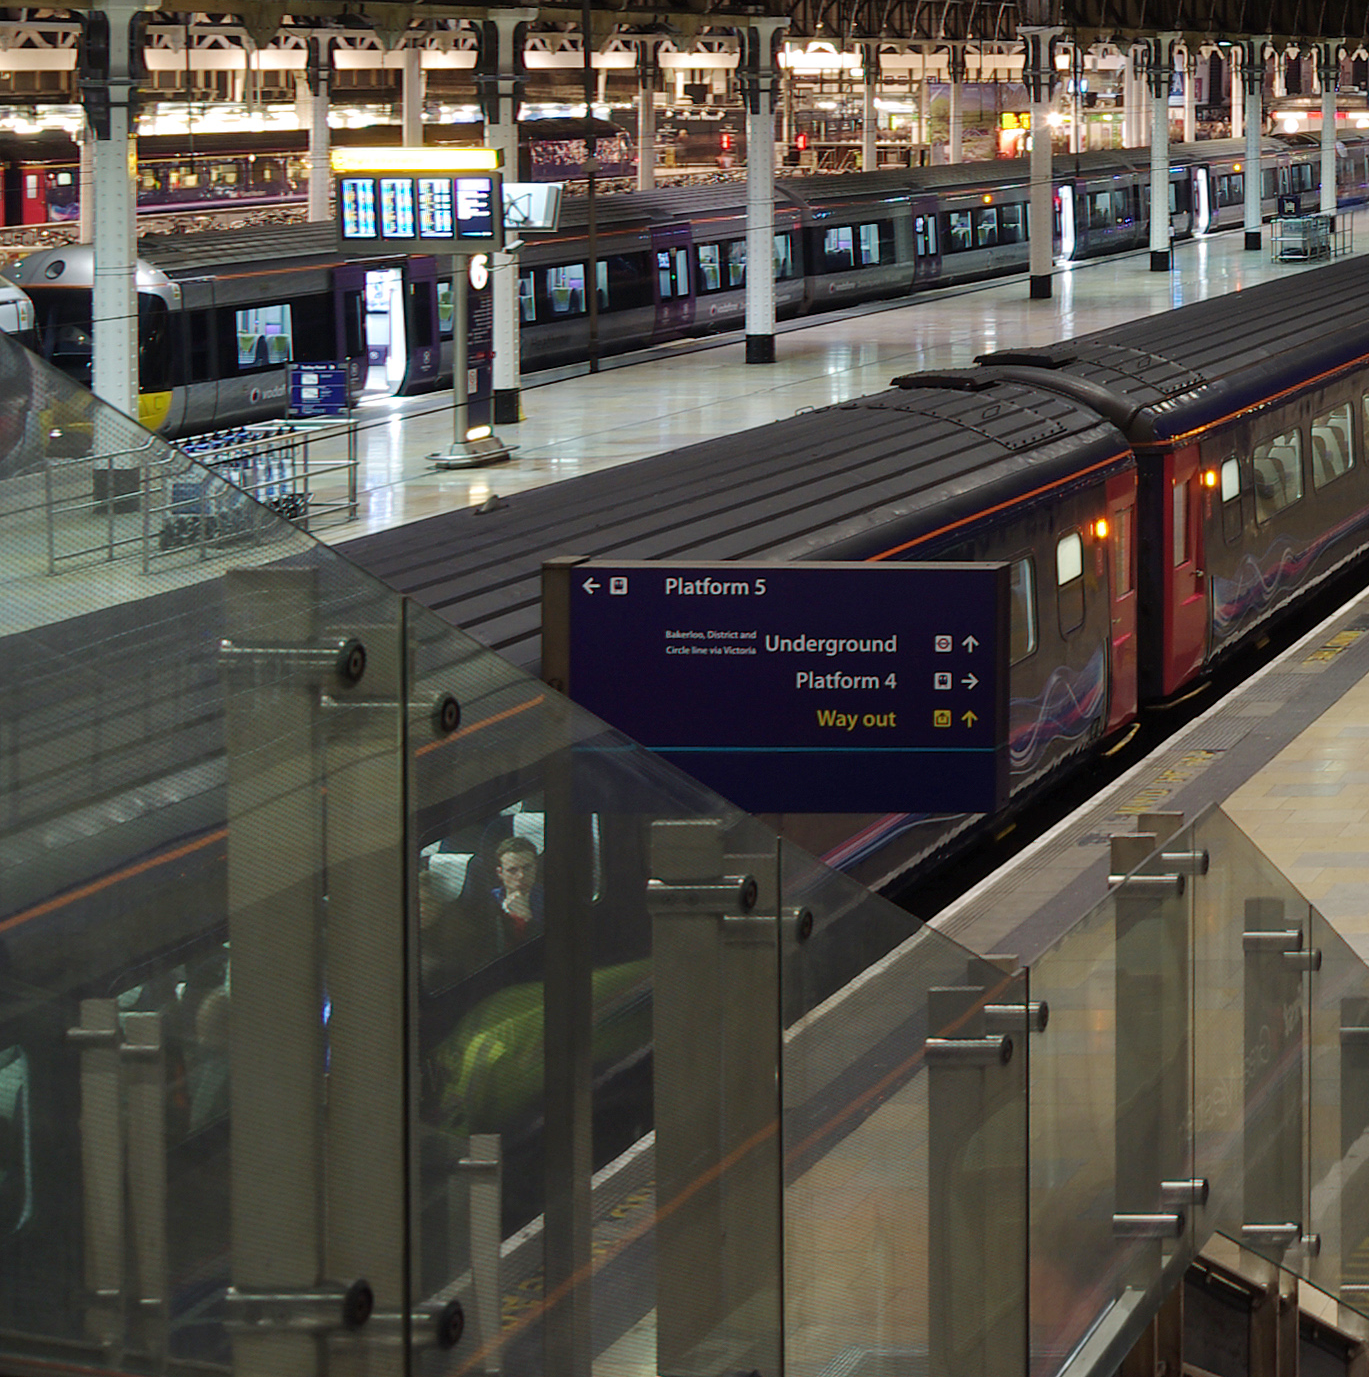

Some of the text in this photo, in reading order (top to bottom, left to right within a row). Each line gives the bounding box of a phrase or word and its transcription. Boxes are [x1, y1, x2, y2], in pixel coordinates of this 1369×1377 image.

[470, 253, 488, 290] 6
[665, 576, 767, 595] Platform 5
[665, 629, 758, 640] Bakerloo, District and
[665, 645, 757, 654] Circle line via Victoria
[765, 633, 898, 657] Underground
[796, 670, 898, 689] Platform 4
[816, 709, 897, 731] Way out
